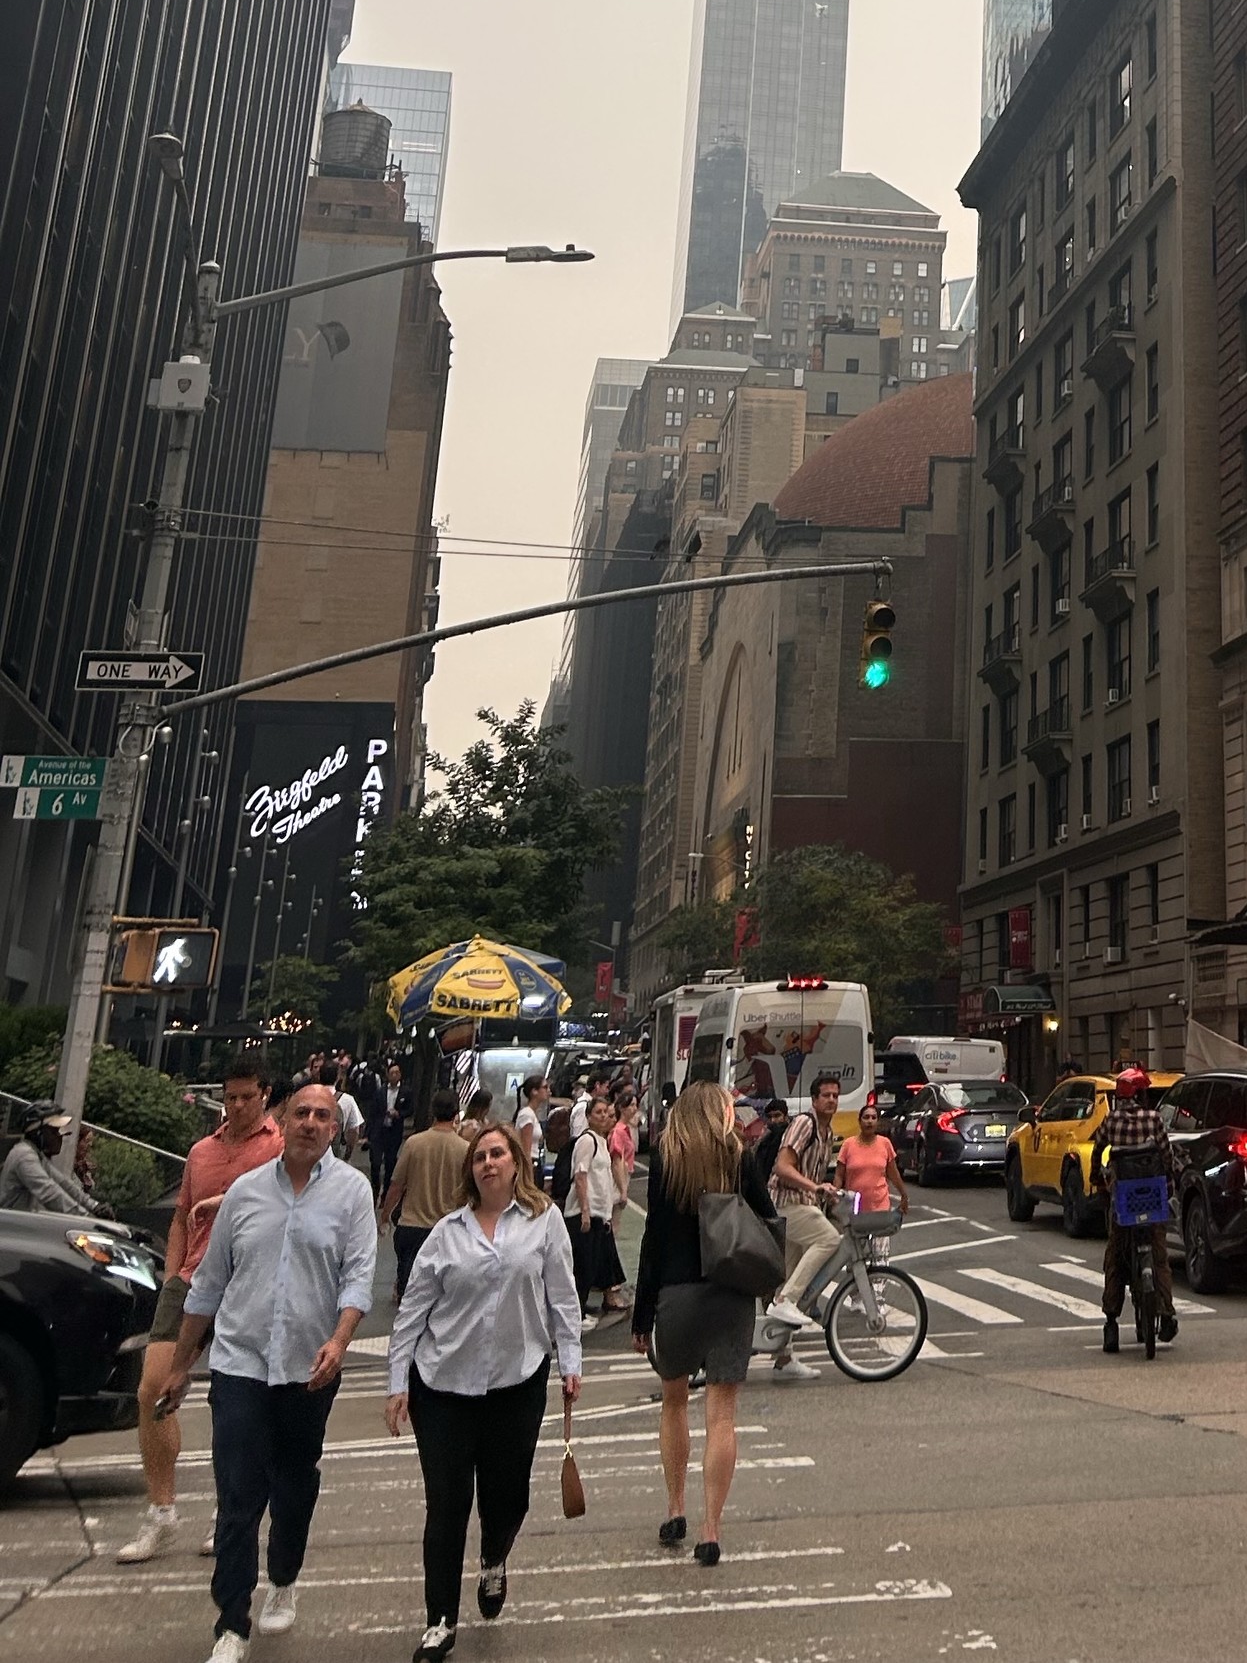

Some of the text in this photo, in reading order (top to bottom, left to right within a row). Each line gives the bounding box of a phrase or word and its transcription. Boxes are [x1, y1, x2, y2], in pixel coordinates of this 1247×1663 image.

[97, 663, 185, 679] ONE WAY
[38, 759, 92, 769] Avenue of the
[28, 769, 97, 786] Americas
[244, 745, 349, 838] Ziegfeld
[51, 791, 88, 815] 6 Av
[271, 793, 342, 844] Theatre
[745, 825, 754, 844] NY
[436, 994, 517, 1013] SABRETT
[743, 1011, 801, 1023] Uber Shuttle
[511, 1078, 519, 1088] A
